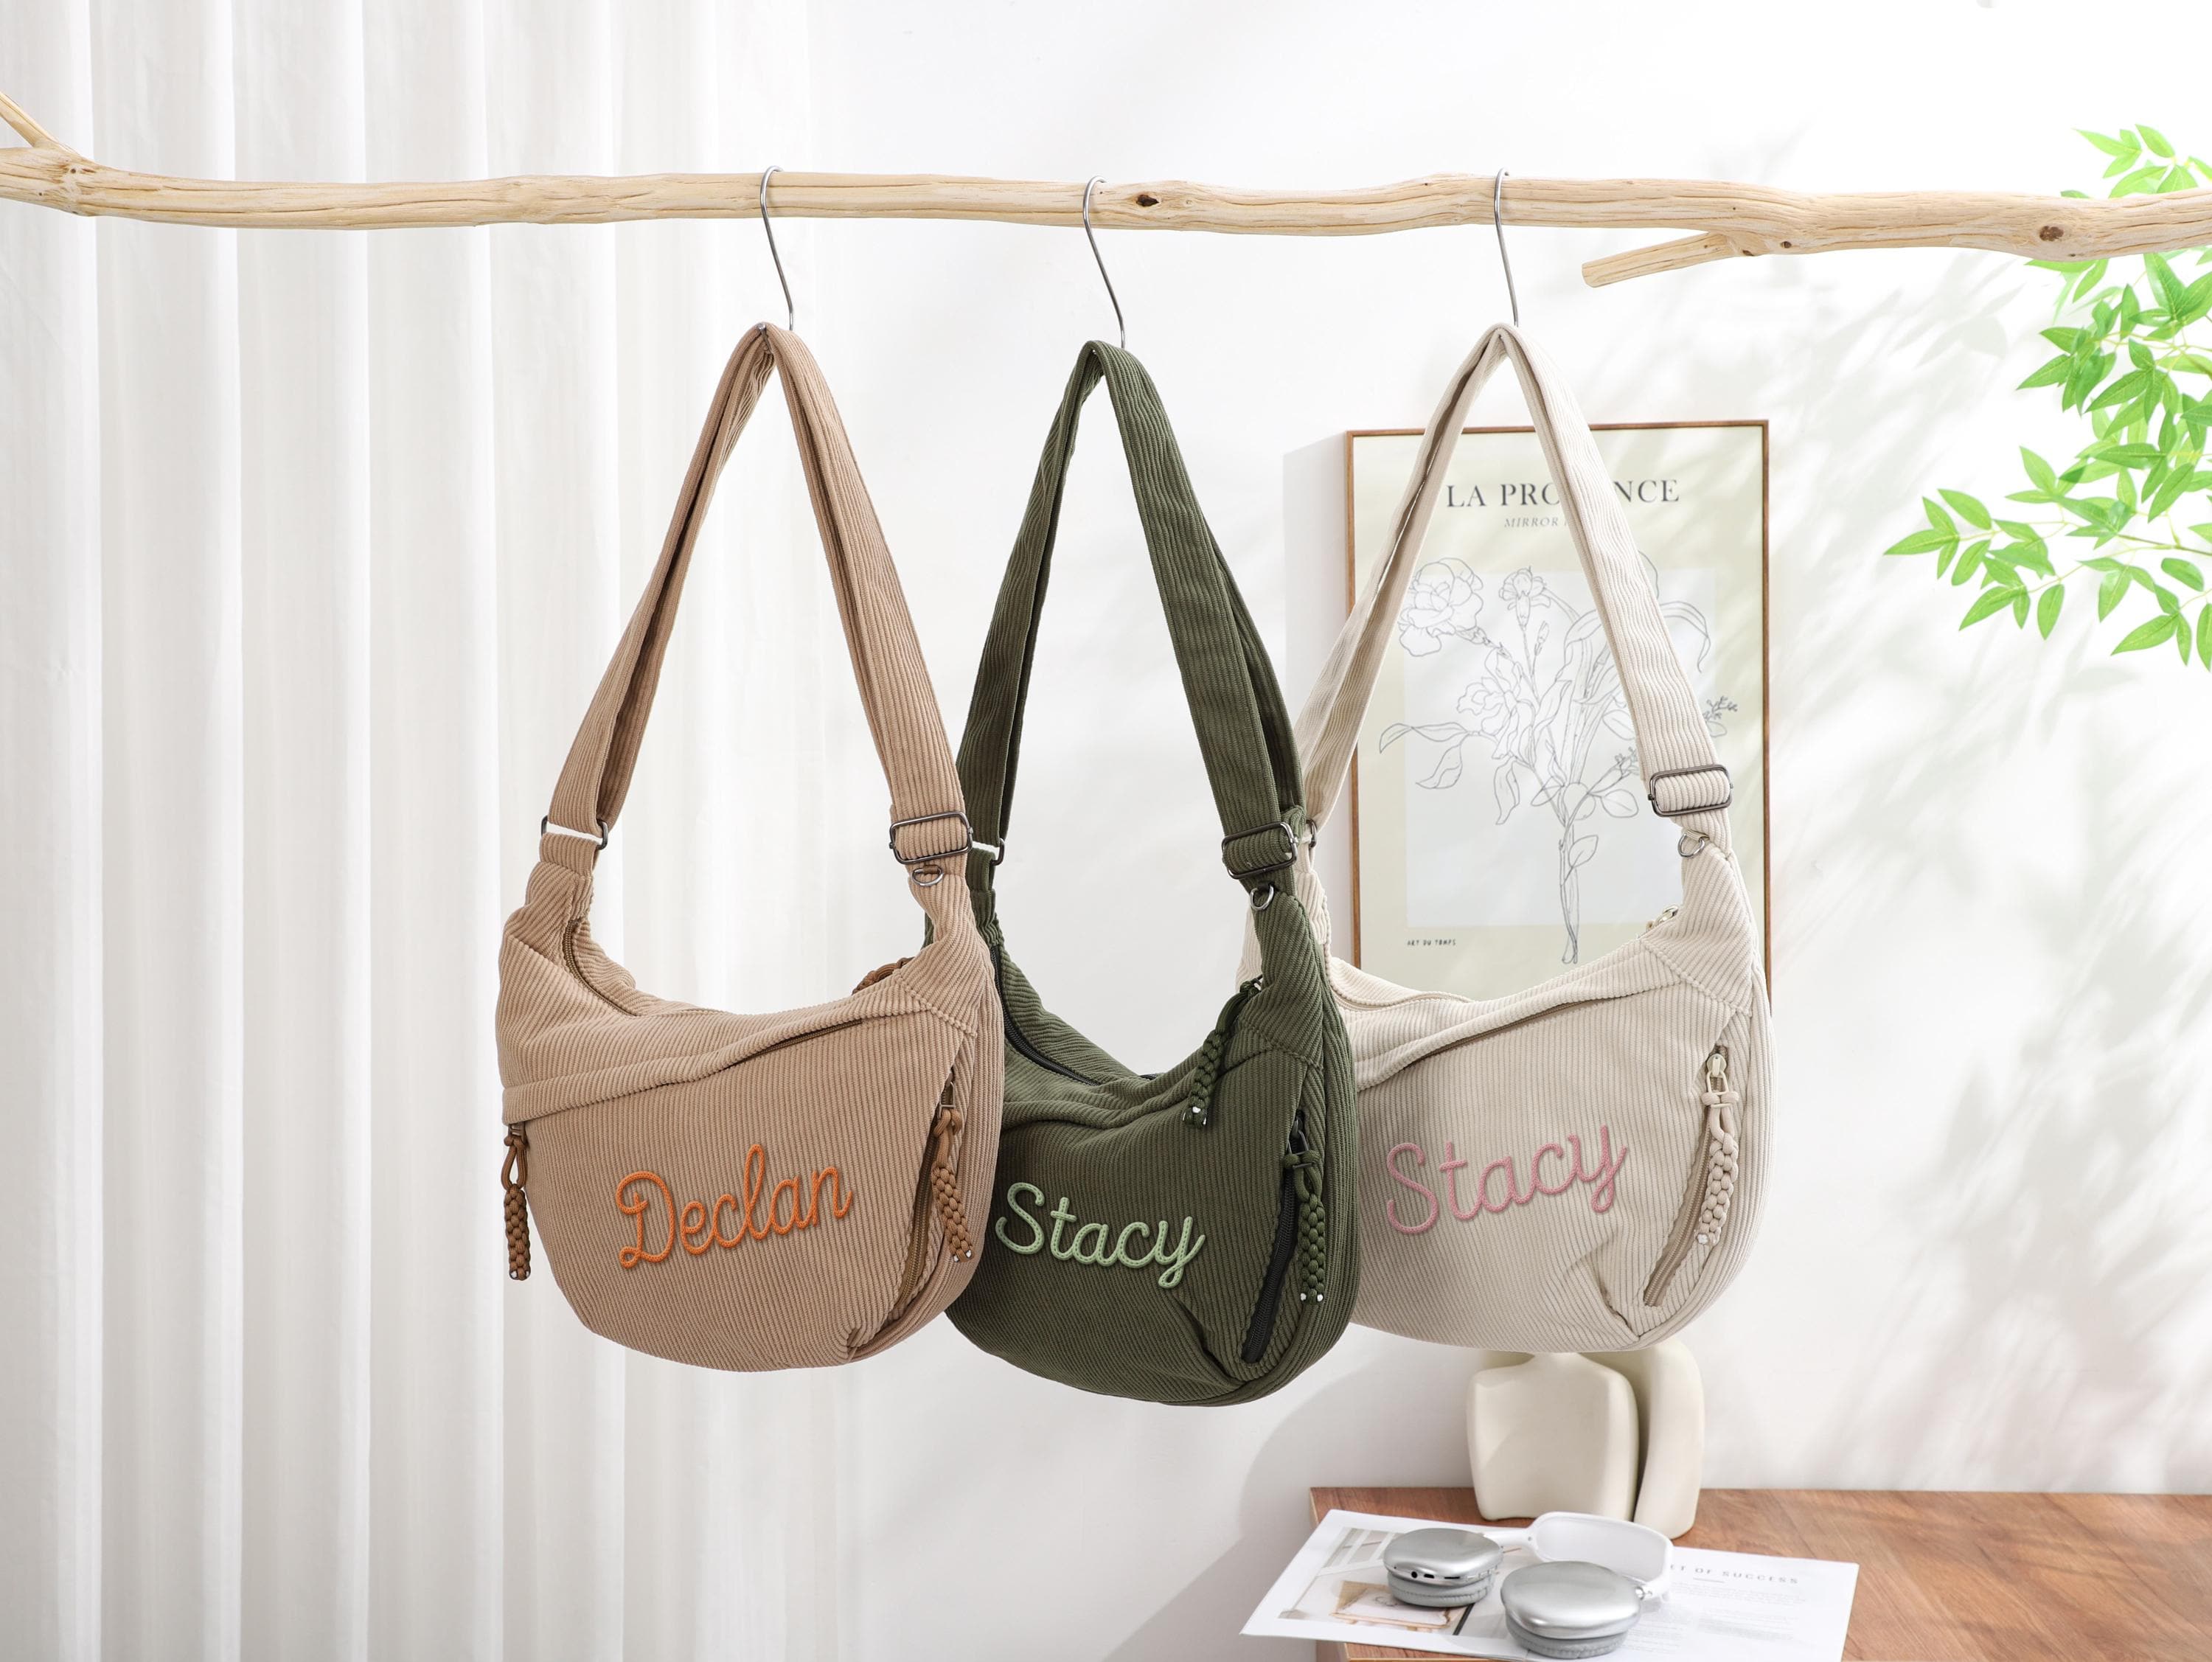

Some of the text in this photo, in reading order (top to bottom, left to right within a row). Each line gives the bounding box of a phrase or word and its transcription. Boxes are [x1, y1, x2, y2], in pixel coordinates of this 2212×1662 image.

[1447, 479, 1680, 507] LA PRONCE
[1503, 517, 1559, 528] MIRROR
[615, 1143, 853, 1269] Declan
[1385, 1124, 1628, 1235] Stacy
[995, 1182, 1206, 1289] Stacy
